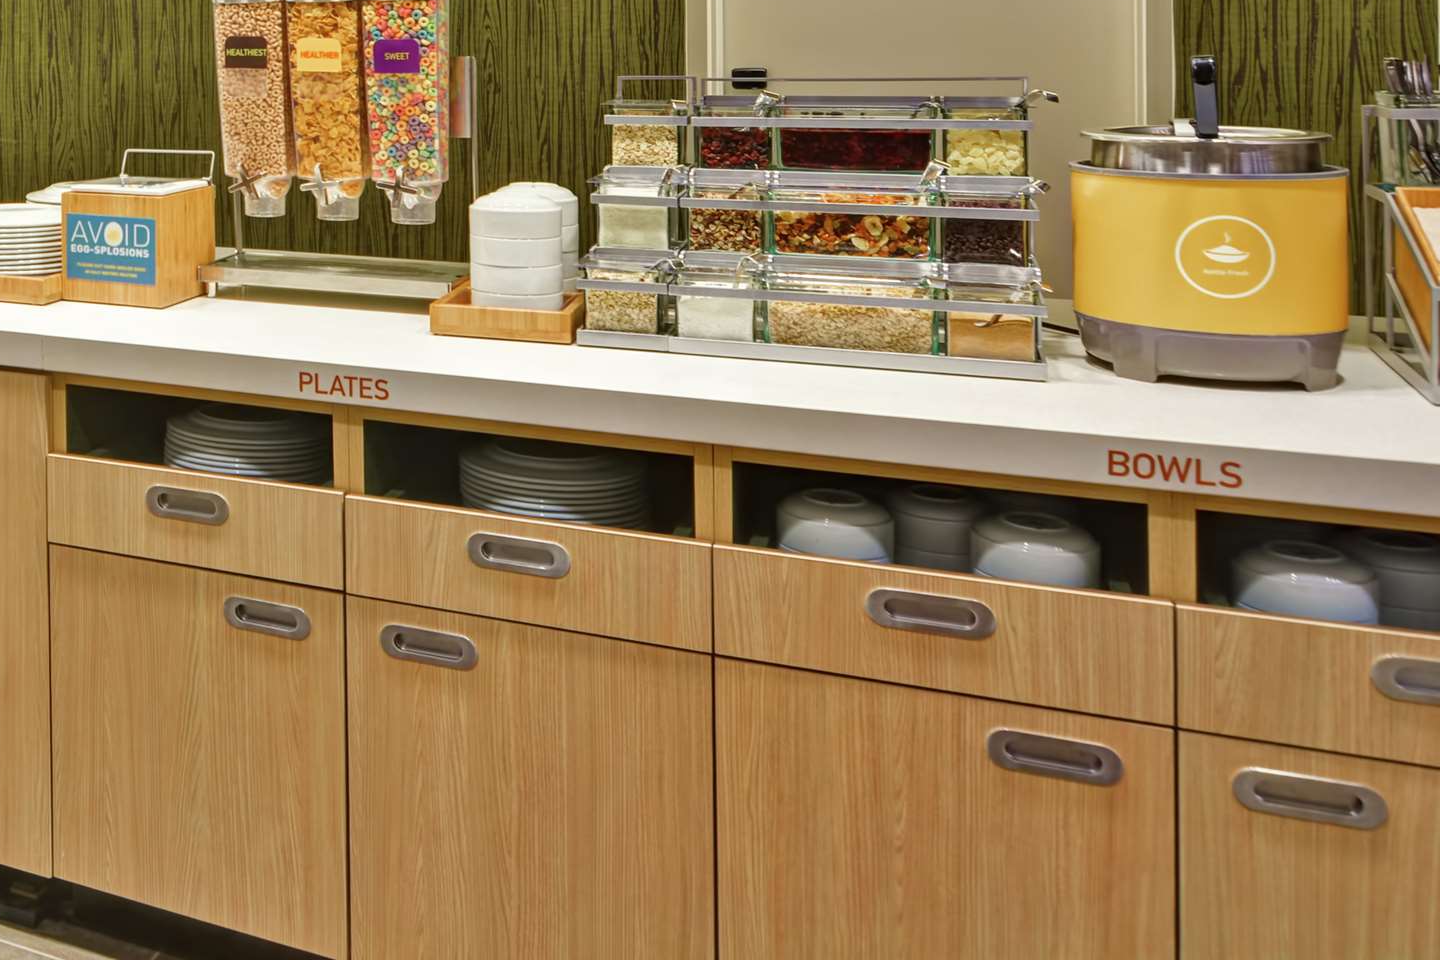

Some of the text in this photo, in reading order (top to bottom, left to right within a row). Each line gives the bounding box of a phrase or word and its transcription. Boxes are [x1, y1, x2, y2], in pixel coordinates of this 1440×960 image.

[225, 48, 267, 57] HEALTHIEST
[383, 52, 409, 61] SWEET
[70, 220, 150, 248] AVOID
[70, 243, 150, 258] EGG-SPLOSIONS
[299, 371, 390, 401] PLATES
[1107, 450, 1243, 489] BOWLS
